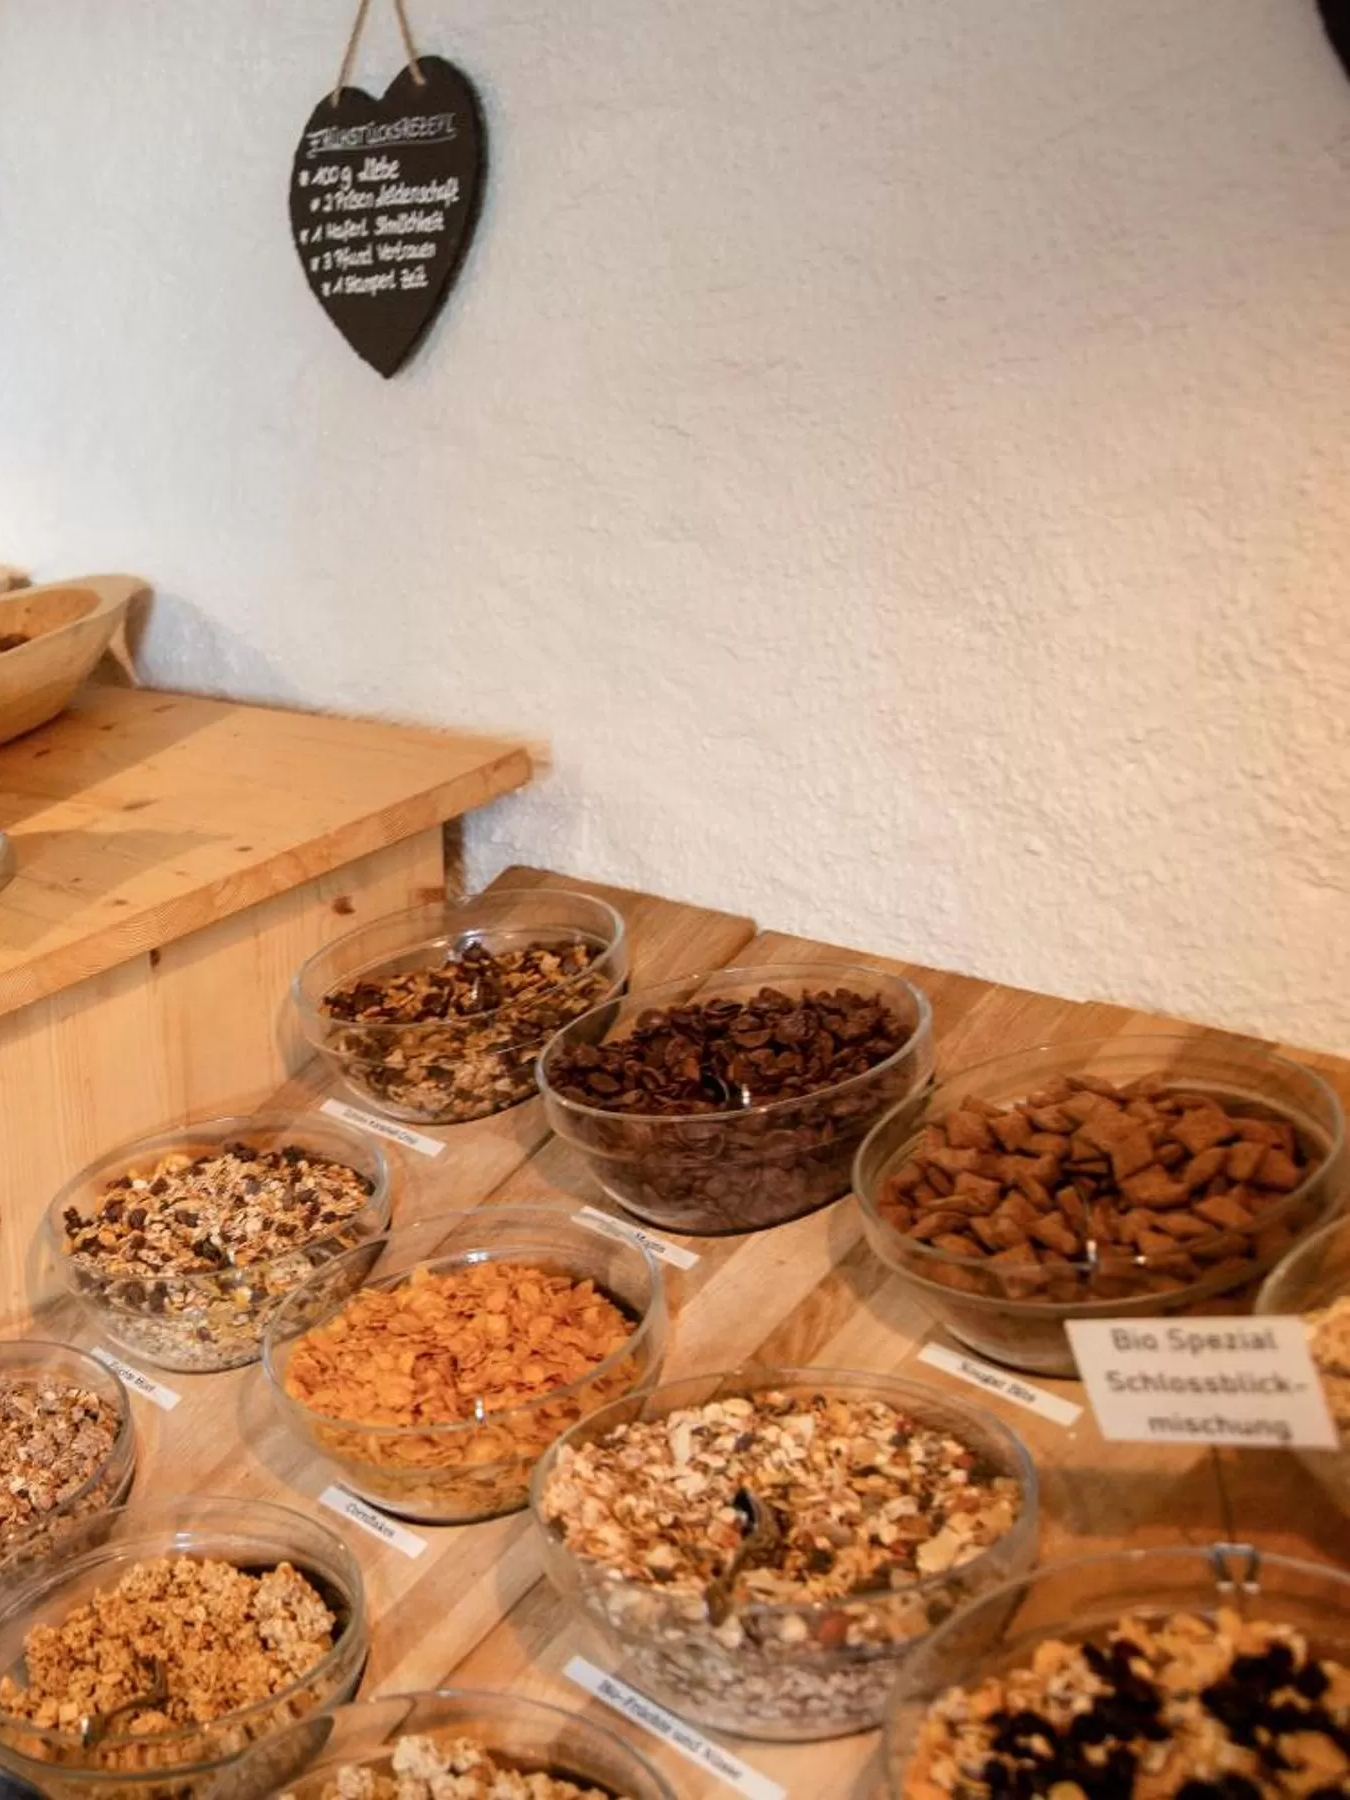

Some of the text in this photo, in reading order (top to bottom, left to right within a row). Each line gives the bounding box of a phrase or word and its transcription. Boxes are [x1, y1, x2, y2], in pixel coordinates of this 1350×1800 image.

[1112, 1326, 1279, 1357] Bio Spezial
[1105, 1369, 1309, 1396] Schlossblick-
[1147, 1415, 1293, 1442] mischung
